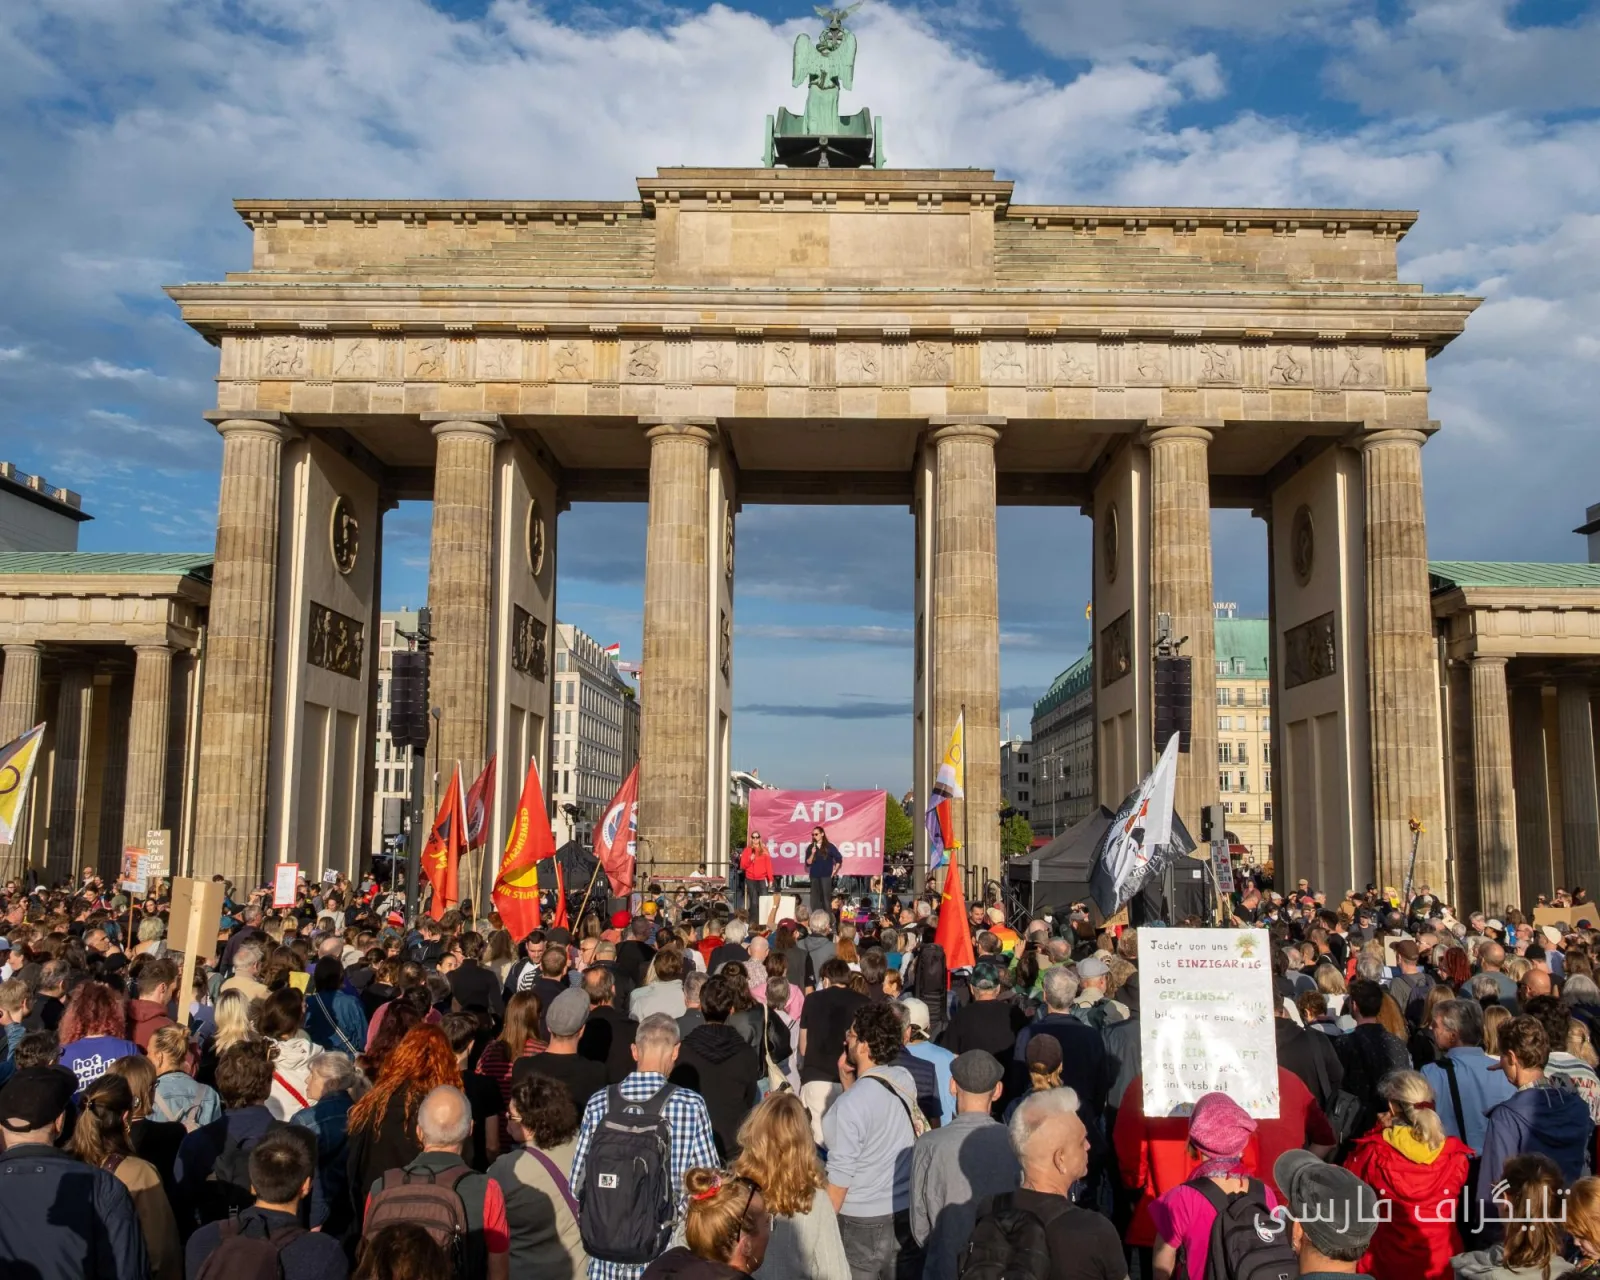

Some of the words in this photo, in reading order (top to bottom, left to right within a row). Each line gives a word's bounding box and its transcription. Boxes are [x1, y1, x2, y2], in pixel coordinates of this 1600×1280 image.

[789, 800, 844, 823] AfD
[766, 837, 881, 864] topen!
[1211, 943, 1229, 951] uns
[1153, 975, 1177, 984] aber
[73, 1054, 101, 1071] hot
